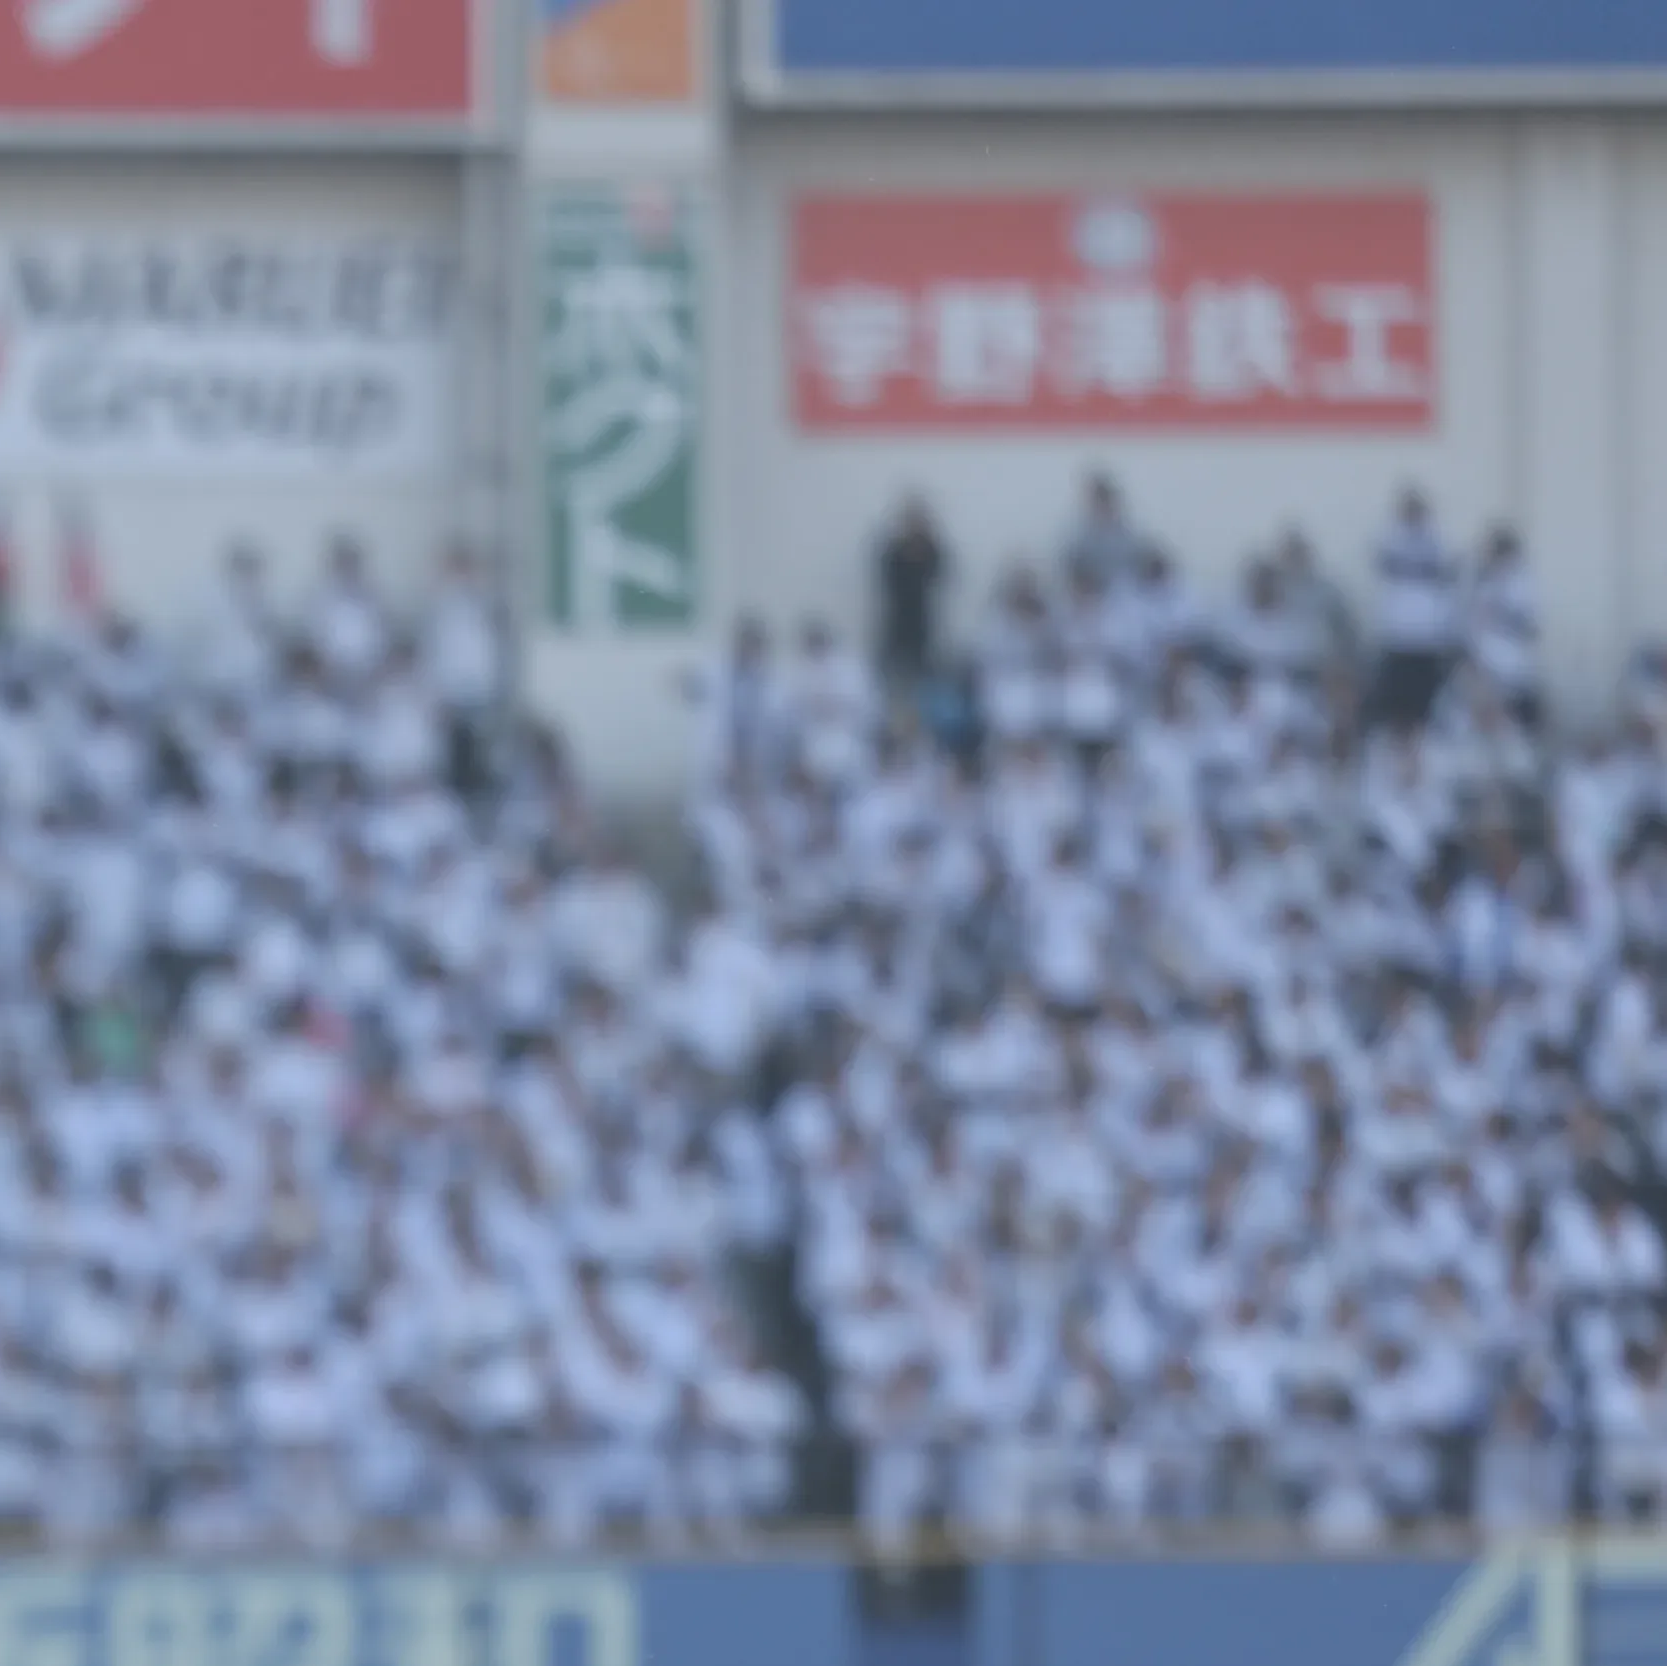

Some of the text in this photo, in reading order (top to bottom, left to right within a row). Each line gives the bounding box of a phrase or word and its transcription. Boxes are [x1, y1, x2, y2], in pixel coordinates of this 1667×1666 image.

[31, 346, 409, 464] Group
[549, 248, 687, 628] ホクト
